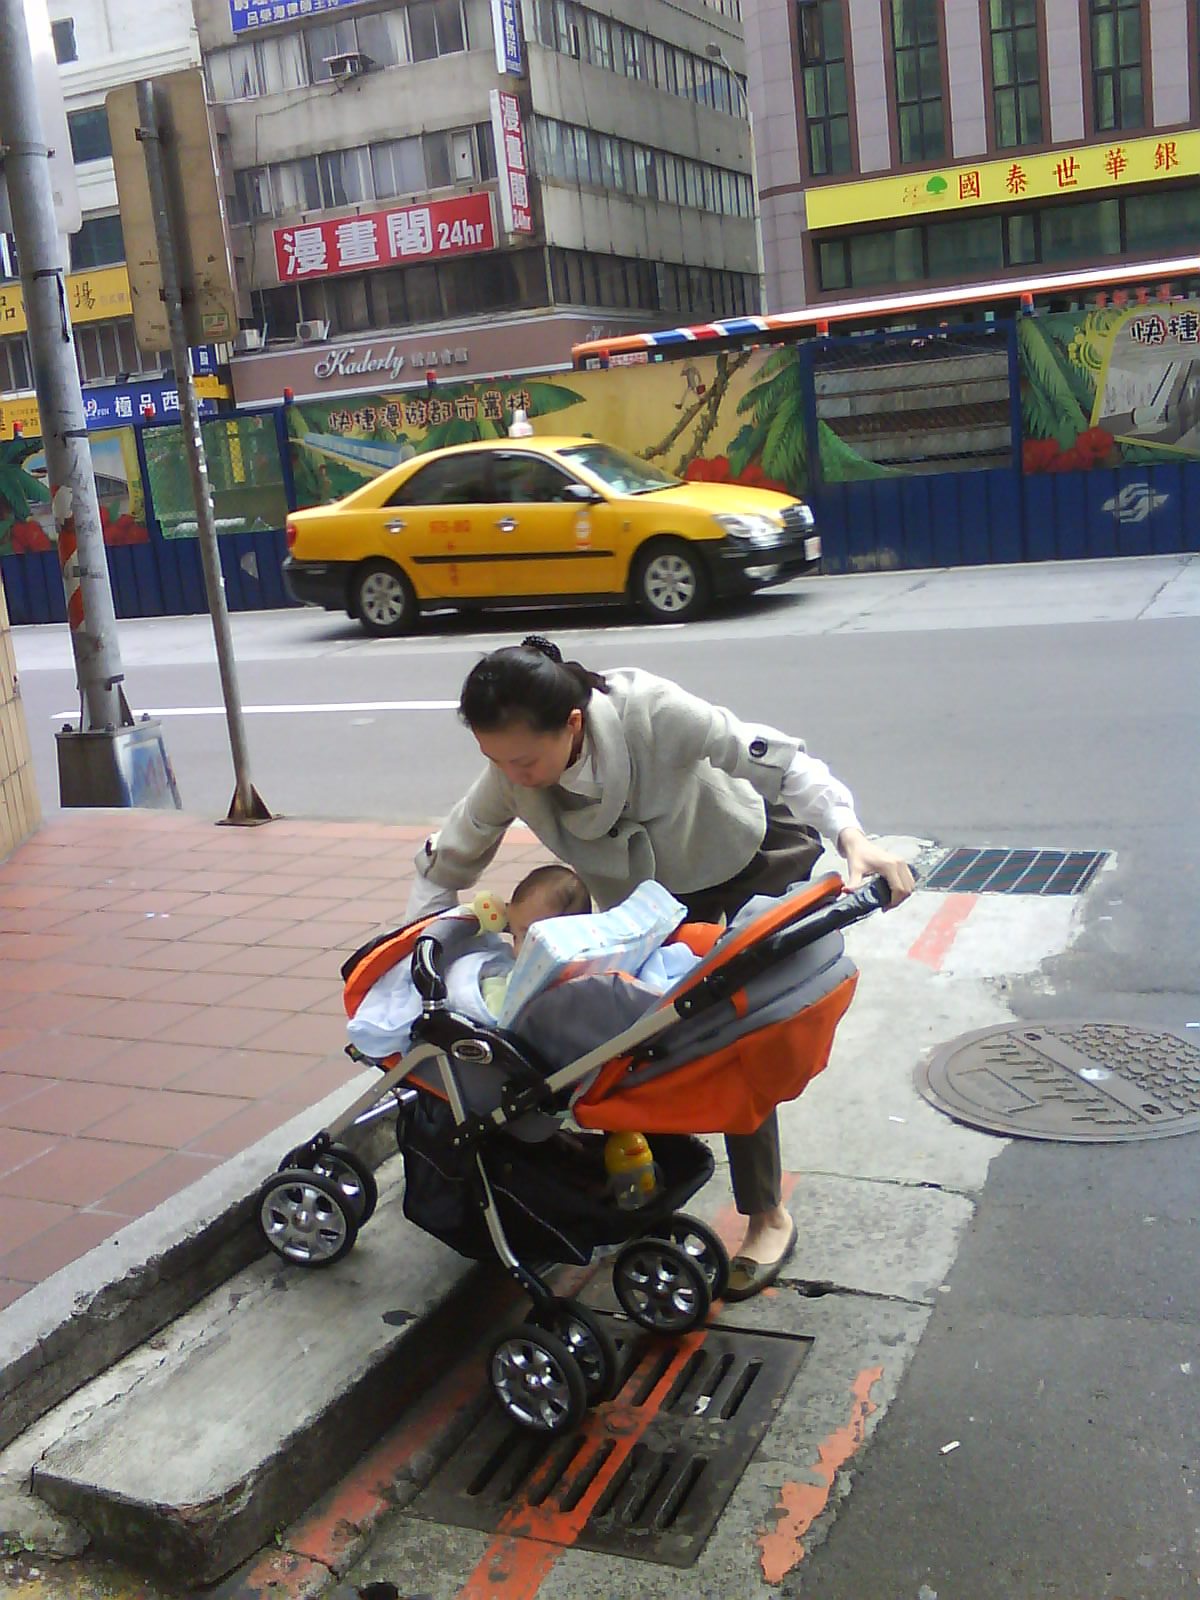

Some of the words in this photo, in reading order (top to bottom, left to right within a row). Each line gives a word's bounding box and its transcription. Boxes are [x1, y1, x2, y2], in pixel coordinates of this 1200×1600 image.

[958, 140, 1180, 201] 國泰世華銀
[283, 207, 435, 276] 漫畫閣
[437, 219, 484, 250] 24hr
[1129, 311, 1200, 345] 快捷
[314, 345, 405, 380] Kaderly
